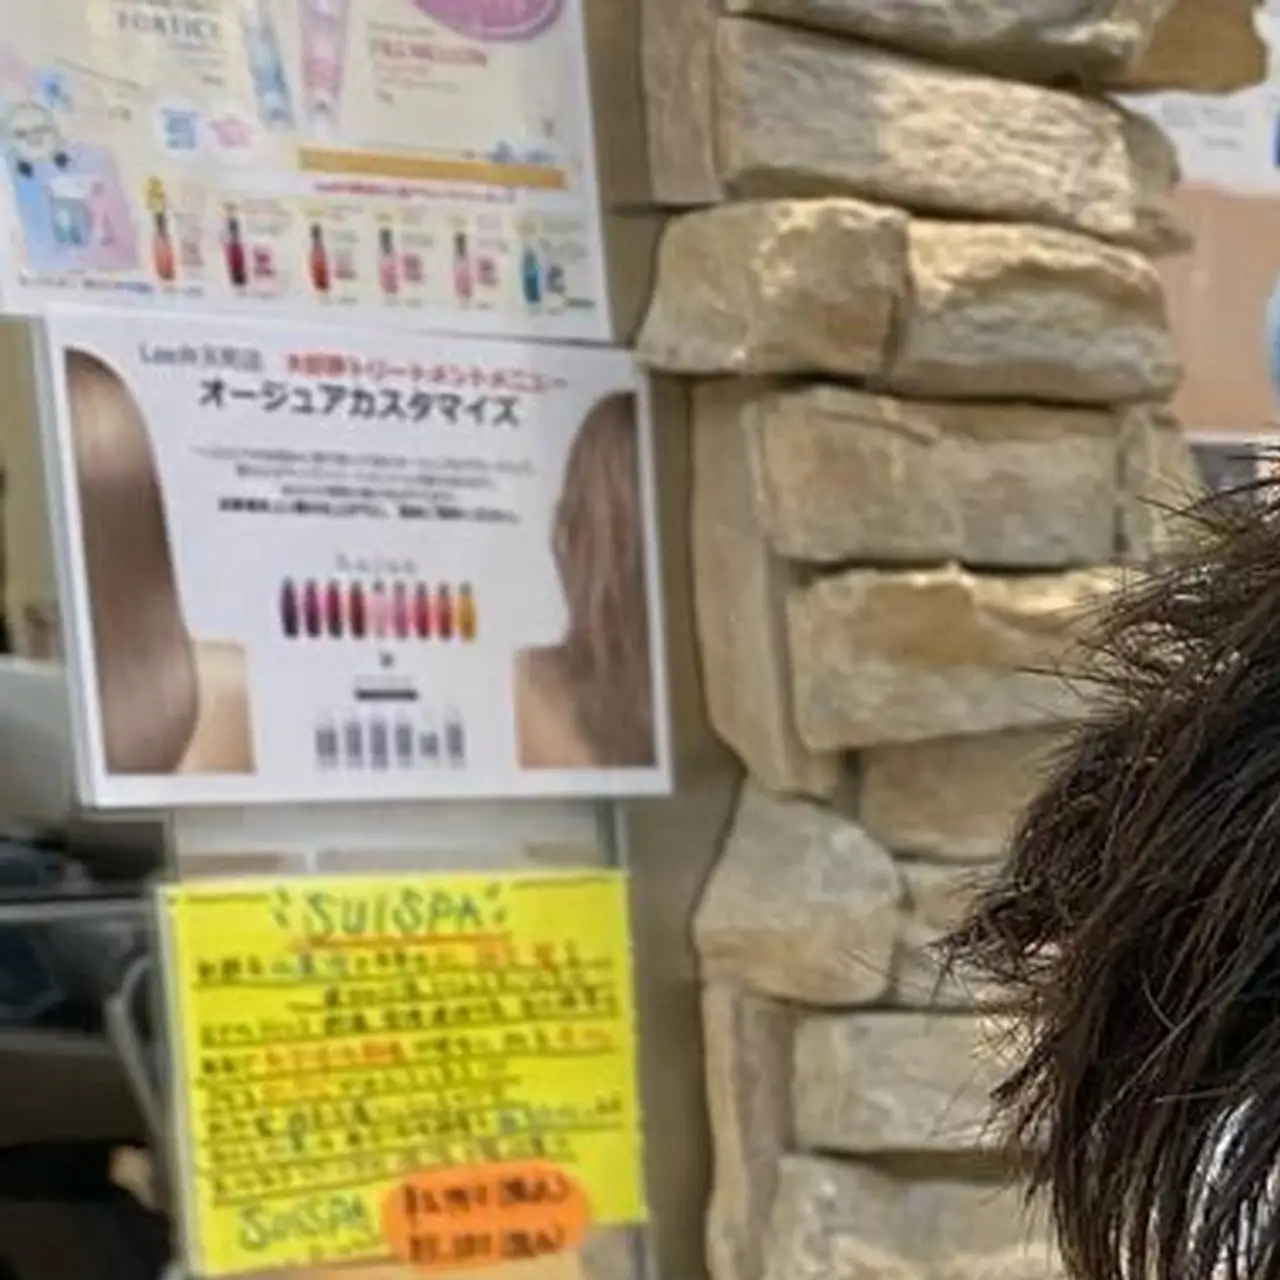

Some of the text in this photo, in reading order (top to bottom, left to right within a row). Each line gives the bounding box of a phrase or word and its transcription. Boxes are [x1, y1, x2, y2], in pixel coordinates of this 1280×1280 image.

[197, 375, 521, 428] オージュアカスタマイズ
